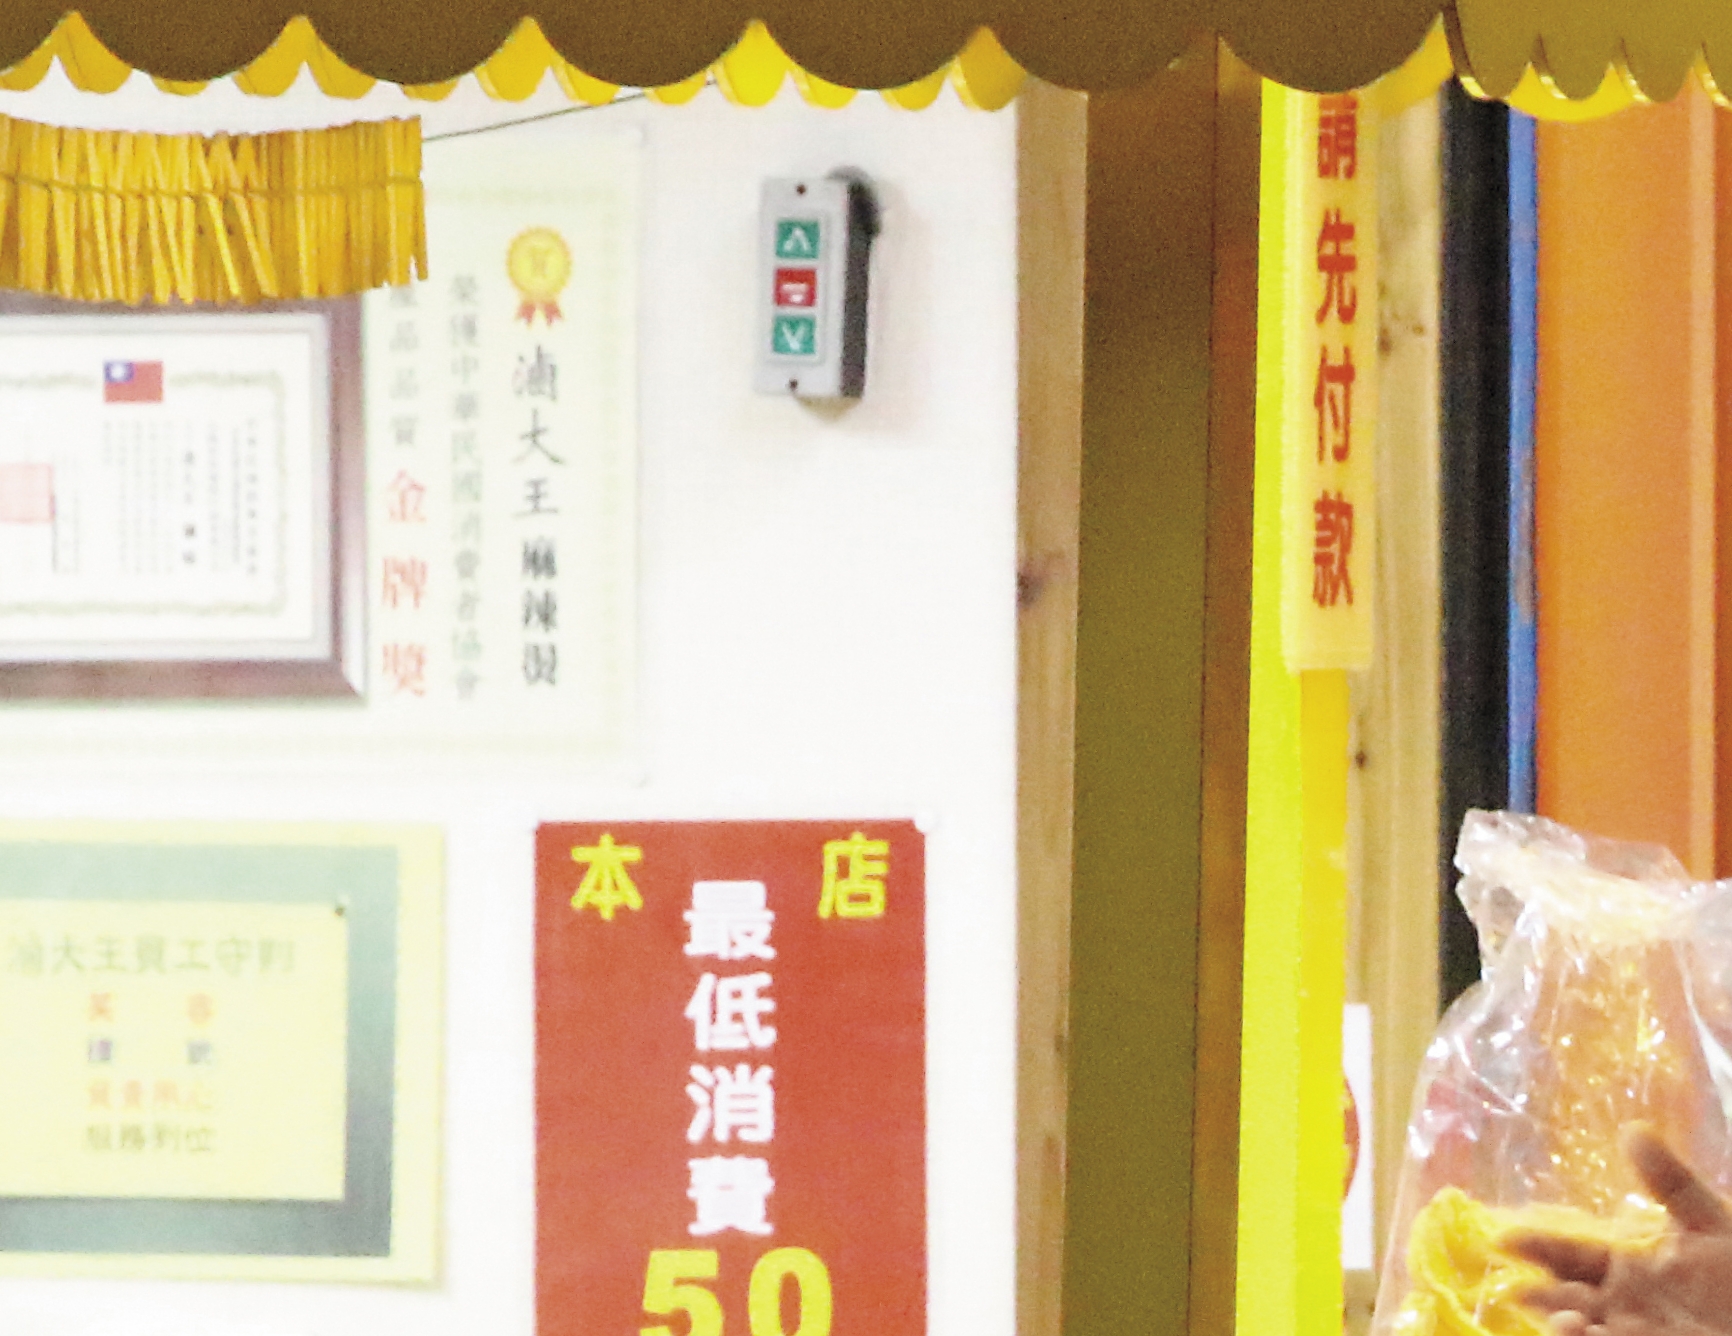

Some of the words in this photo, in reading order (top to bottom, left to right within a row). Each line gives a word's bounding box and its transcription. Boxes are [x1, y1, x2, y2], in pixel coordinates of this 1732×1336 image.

[1312, 92, 1357, 607] 請先付款
[570, 832, 645, 920] 本
[818, 832, 892, 920] 店
[683, 879, 777, 1237] 最低消費
